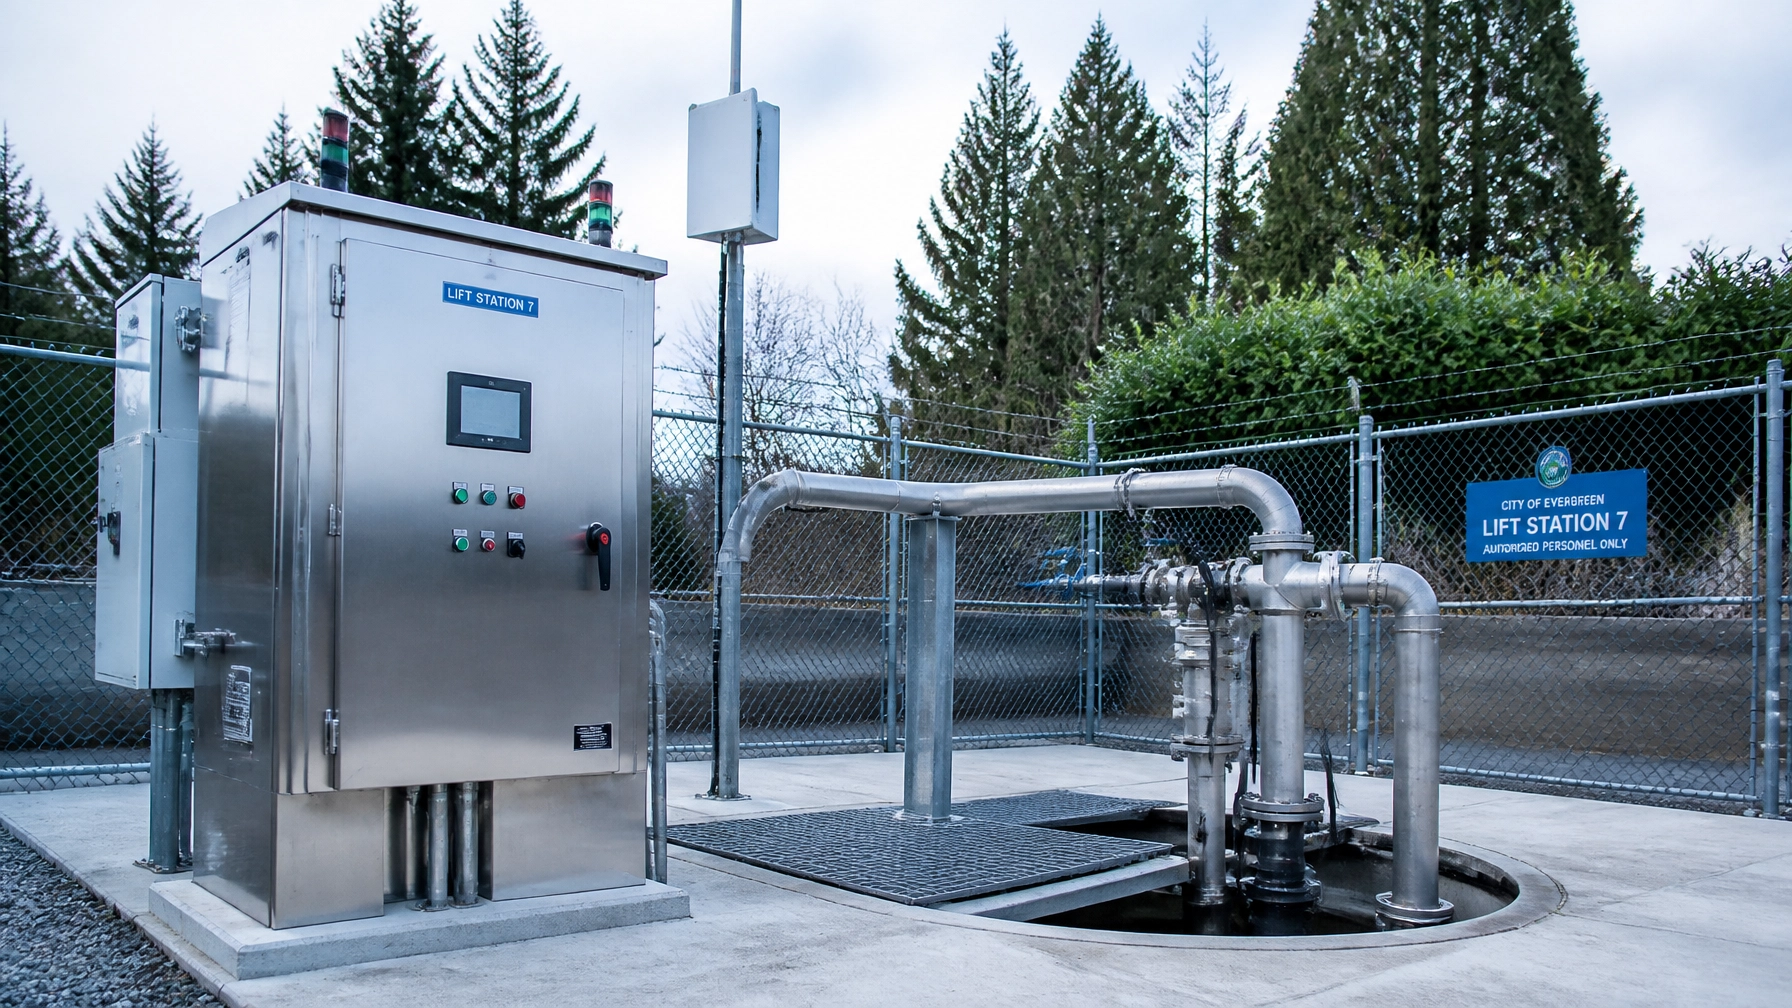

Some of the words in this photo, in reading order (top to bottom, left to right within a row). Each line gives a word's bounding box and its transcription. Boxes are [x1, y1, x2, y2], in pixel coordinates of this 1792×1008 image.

[447, 288, 472, 301] LIFT
[476, 292, 524, 311] STATION
[527, 301, 534, 312] 7
[1501, 500, 1525, 510] CITY
[1527, 498, 1541, 508] OF
[1483, 518, 1521, 536] LIFT
[1526, 512, 1609, 534] STATION
[1616, 511, 1629, 530] 7
[1600, 538, 1628, 550] ONLY
